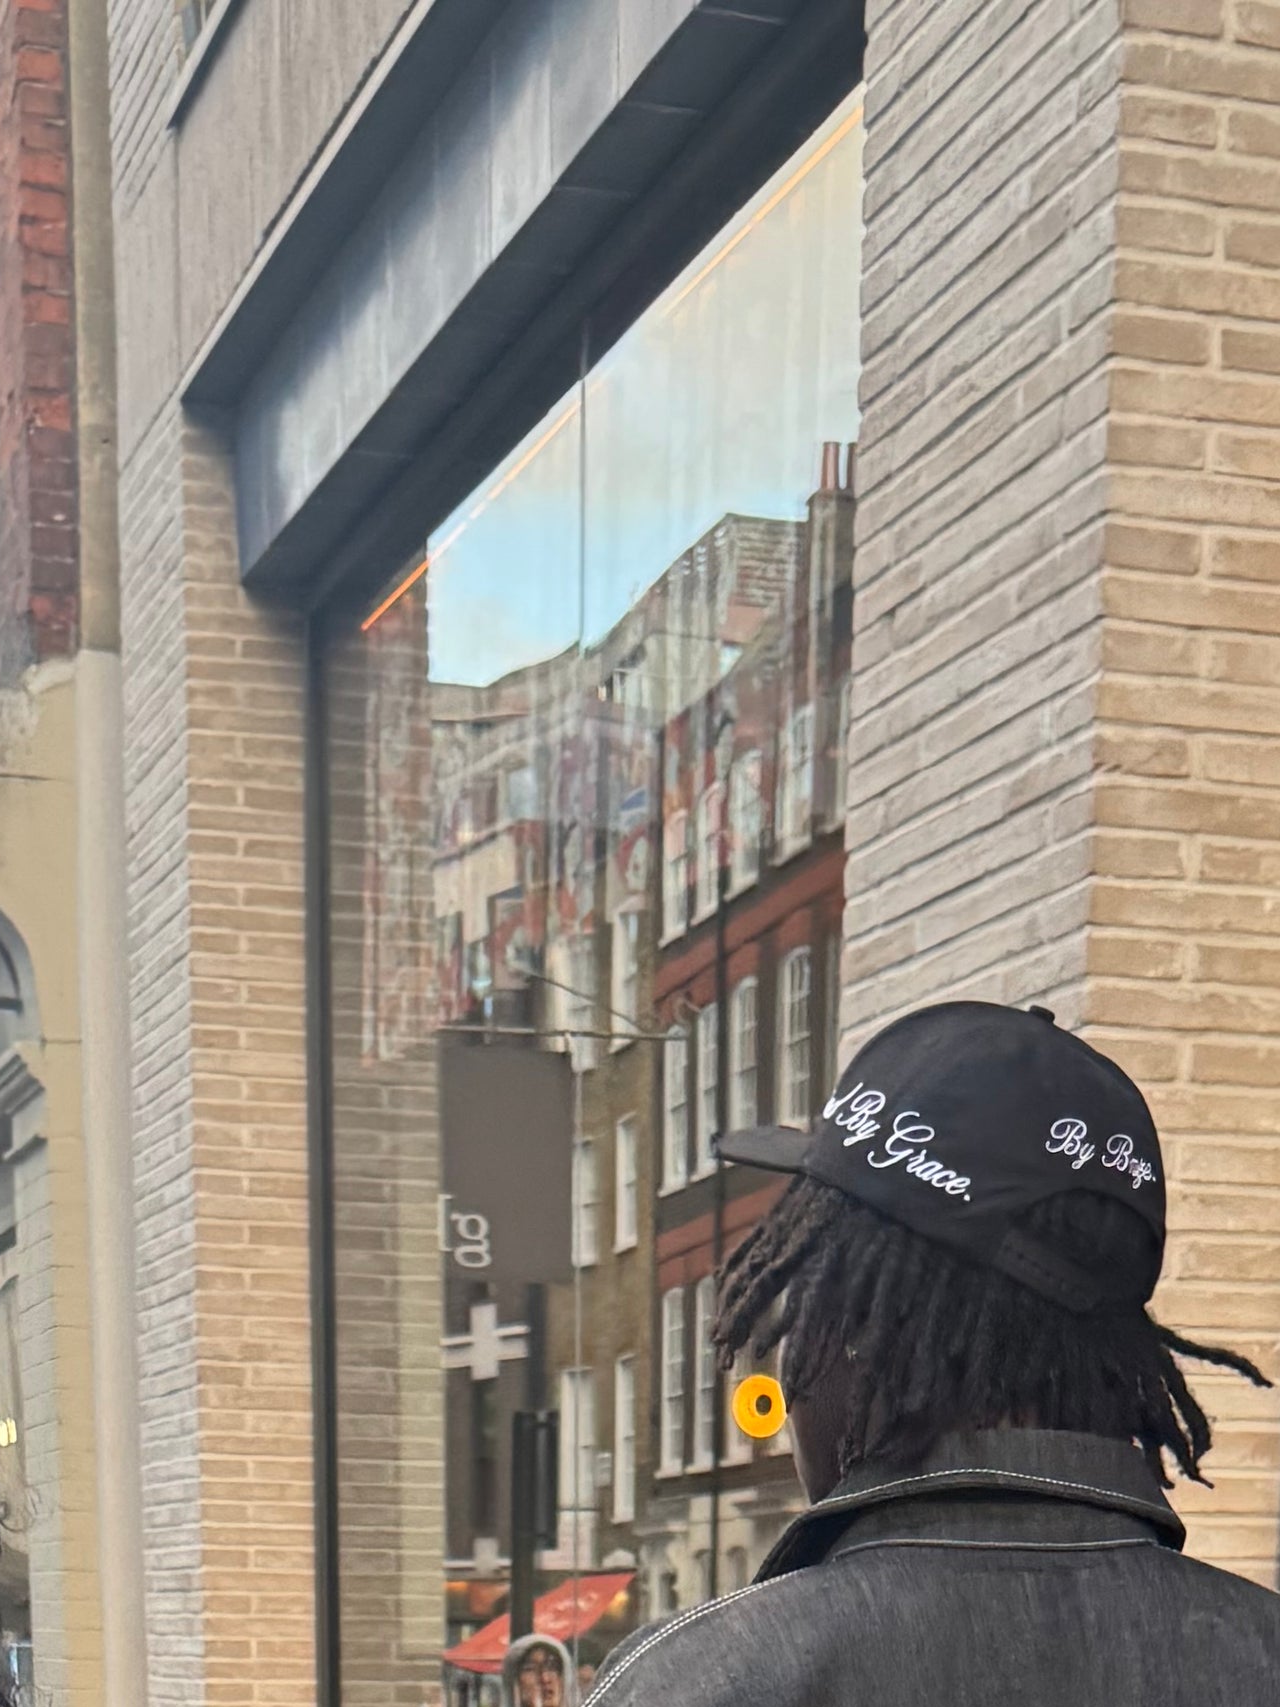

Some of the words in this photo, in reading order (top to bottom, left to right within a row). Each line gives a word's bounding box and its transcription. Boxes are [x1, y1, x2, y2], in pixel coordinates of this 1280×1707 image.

[835, 1090, 886, 1147] By
[867, 1111, 971, 1201] Grace.
[1045, 1118, 1096, 1170] By
